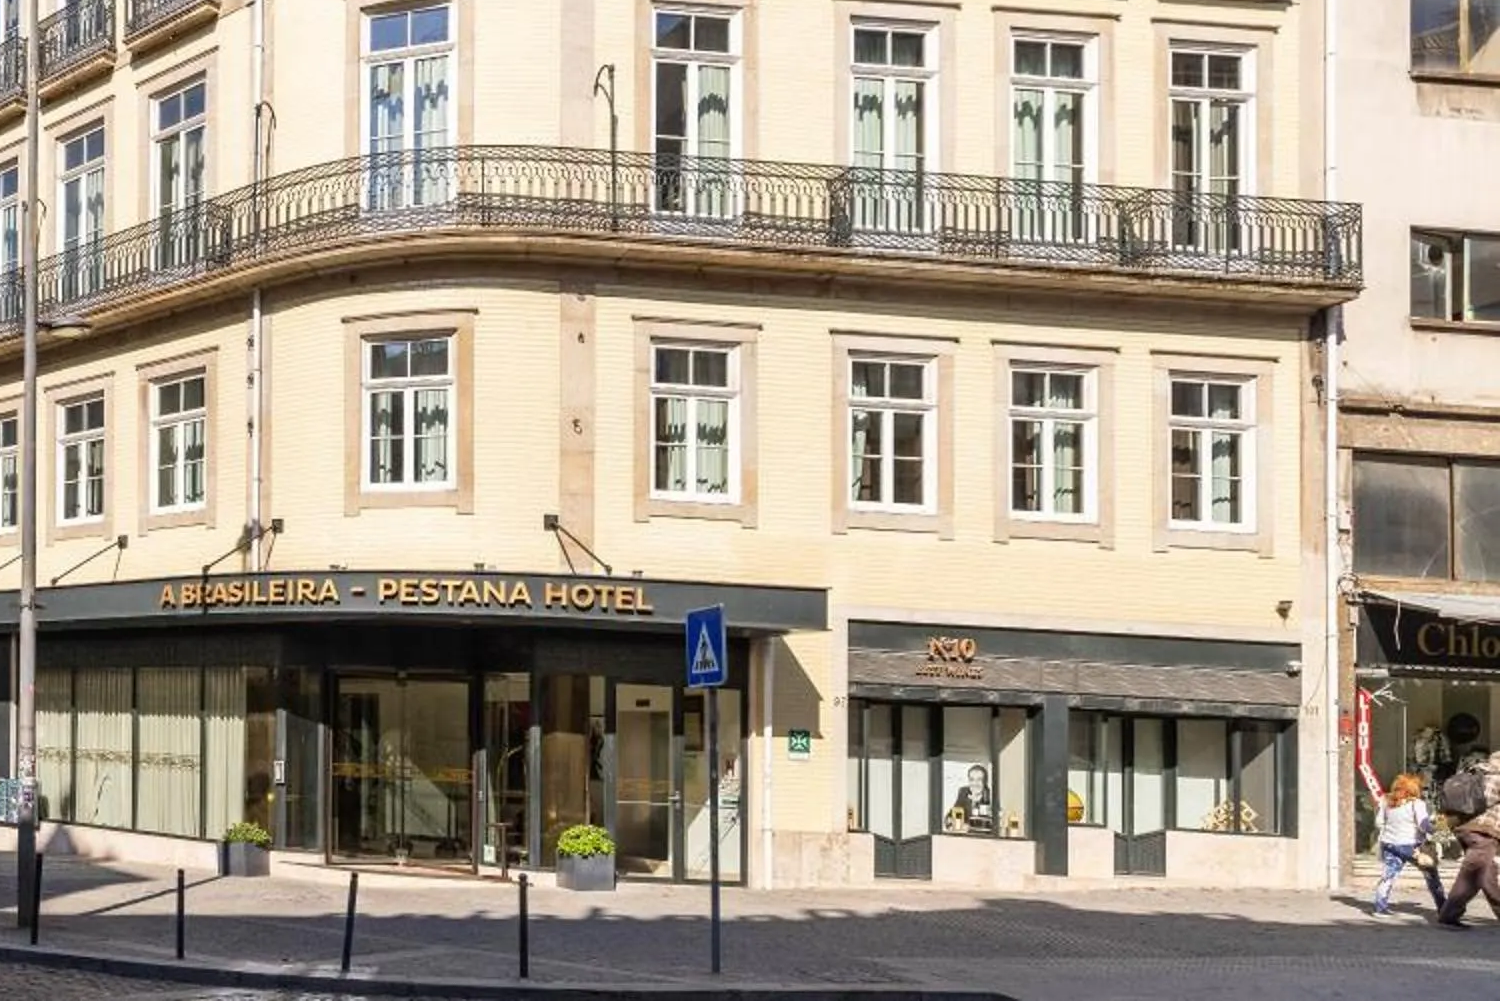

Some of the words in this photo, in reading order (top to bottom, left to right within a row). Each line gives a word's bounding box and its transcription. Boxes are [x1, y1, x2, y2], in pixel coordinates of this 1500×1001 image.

[161, 583, 176, 607] A
[179, 578, 341, 607] BRASILEIRA
[377, 578, 532, 607] PESTANA
[544, 582, 654, 613] HOTEL
